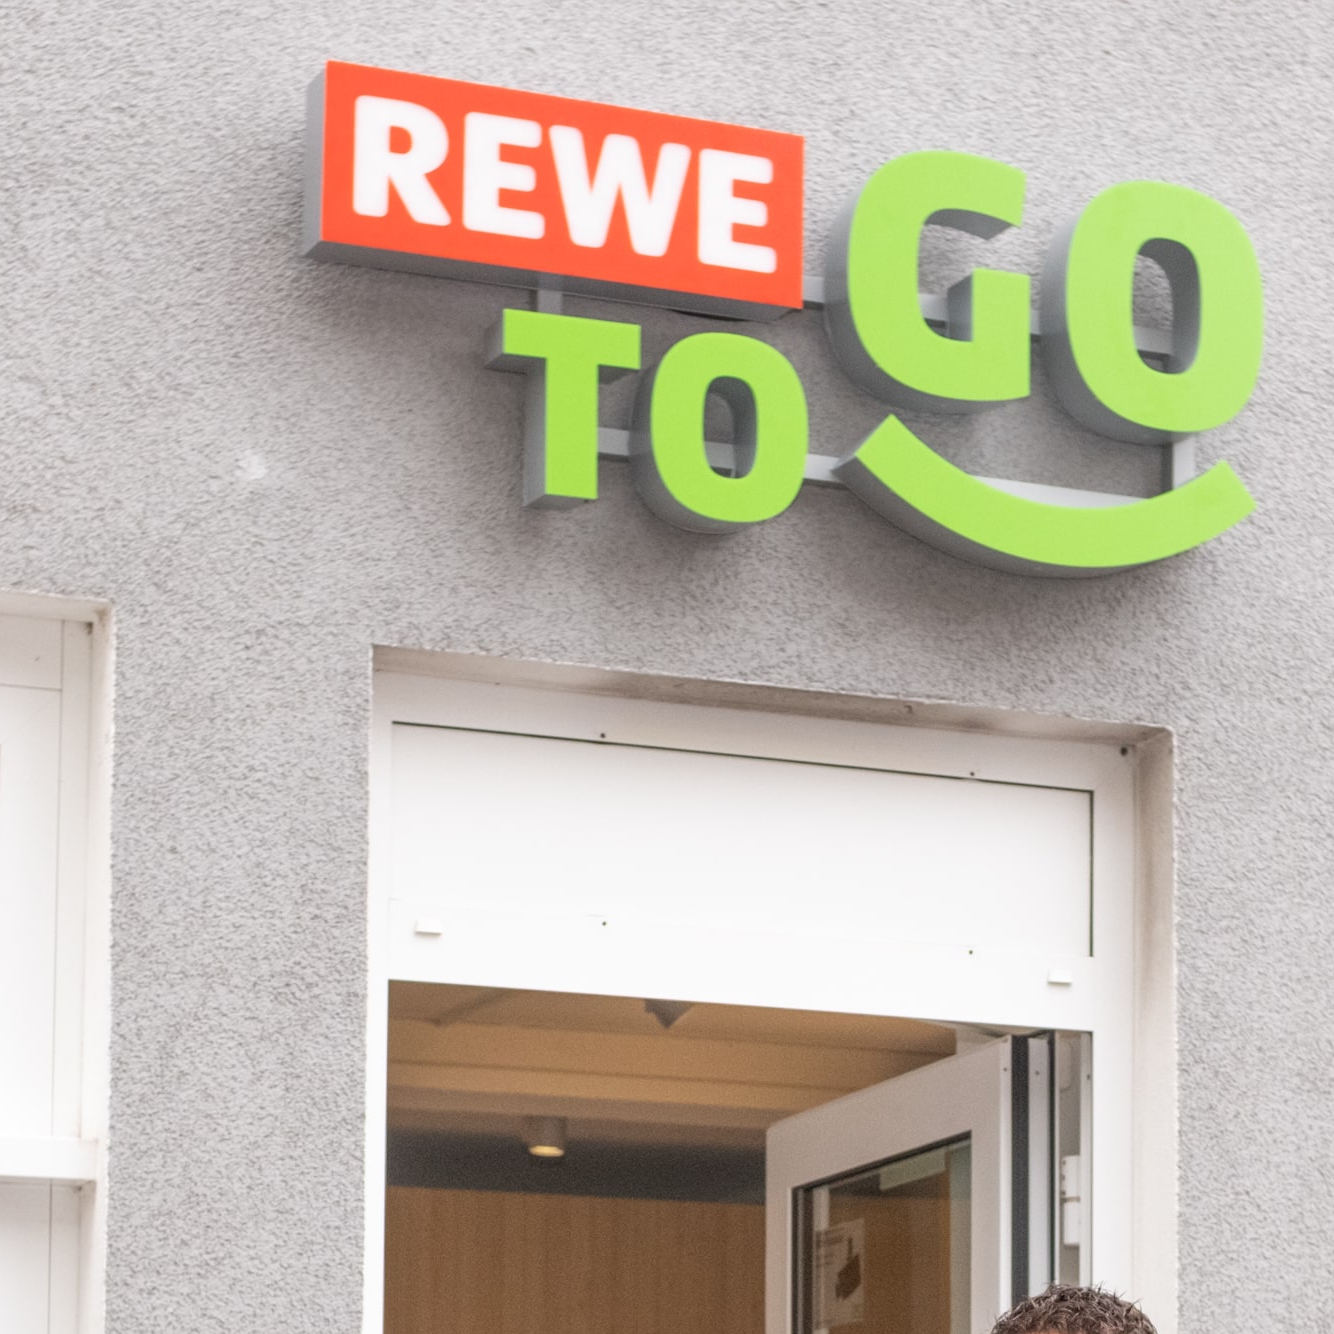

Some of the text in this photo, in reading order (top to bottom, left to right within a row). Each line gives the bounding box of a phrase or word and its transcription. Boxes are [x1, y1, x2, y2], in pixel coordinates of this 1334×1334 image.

[353, 94, 778, 274] REWE
[501, 149, 1267, 524] TO GO
